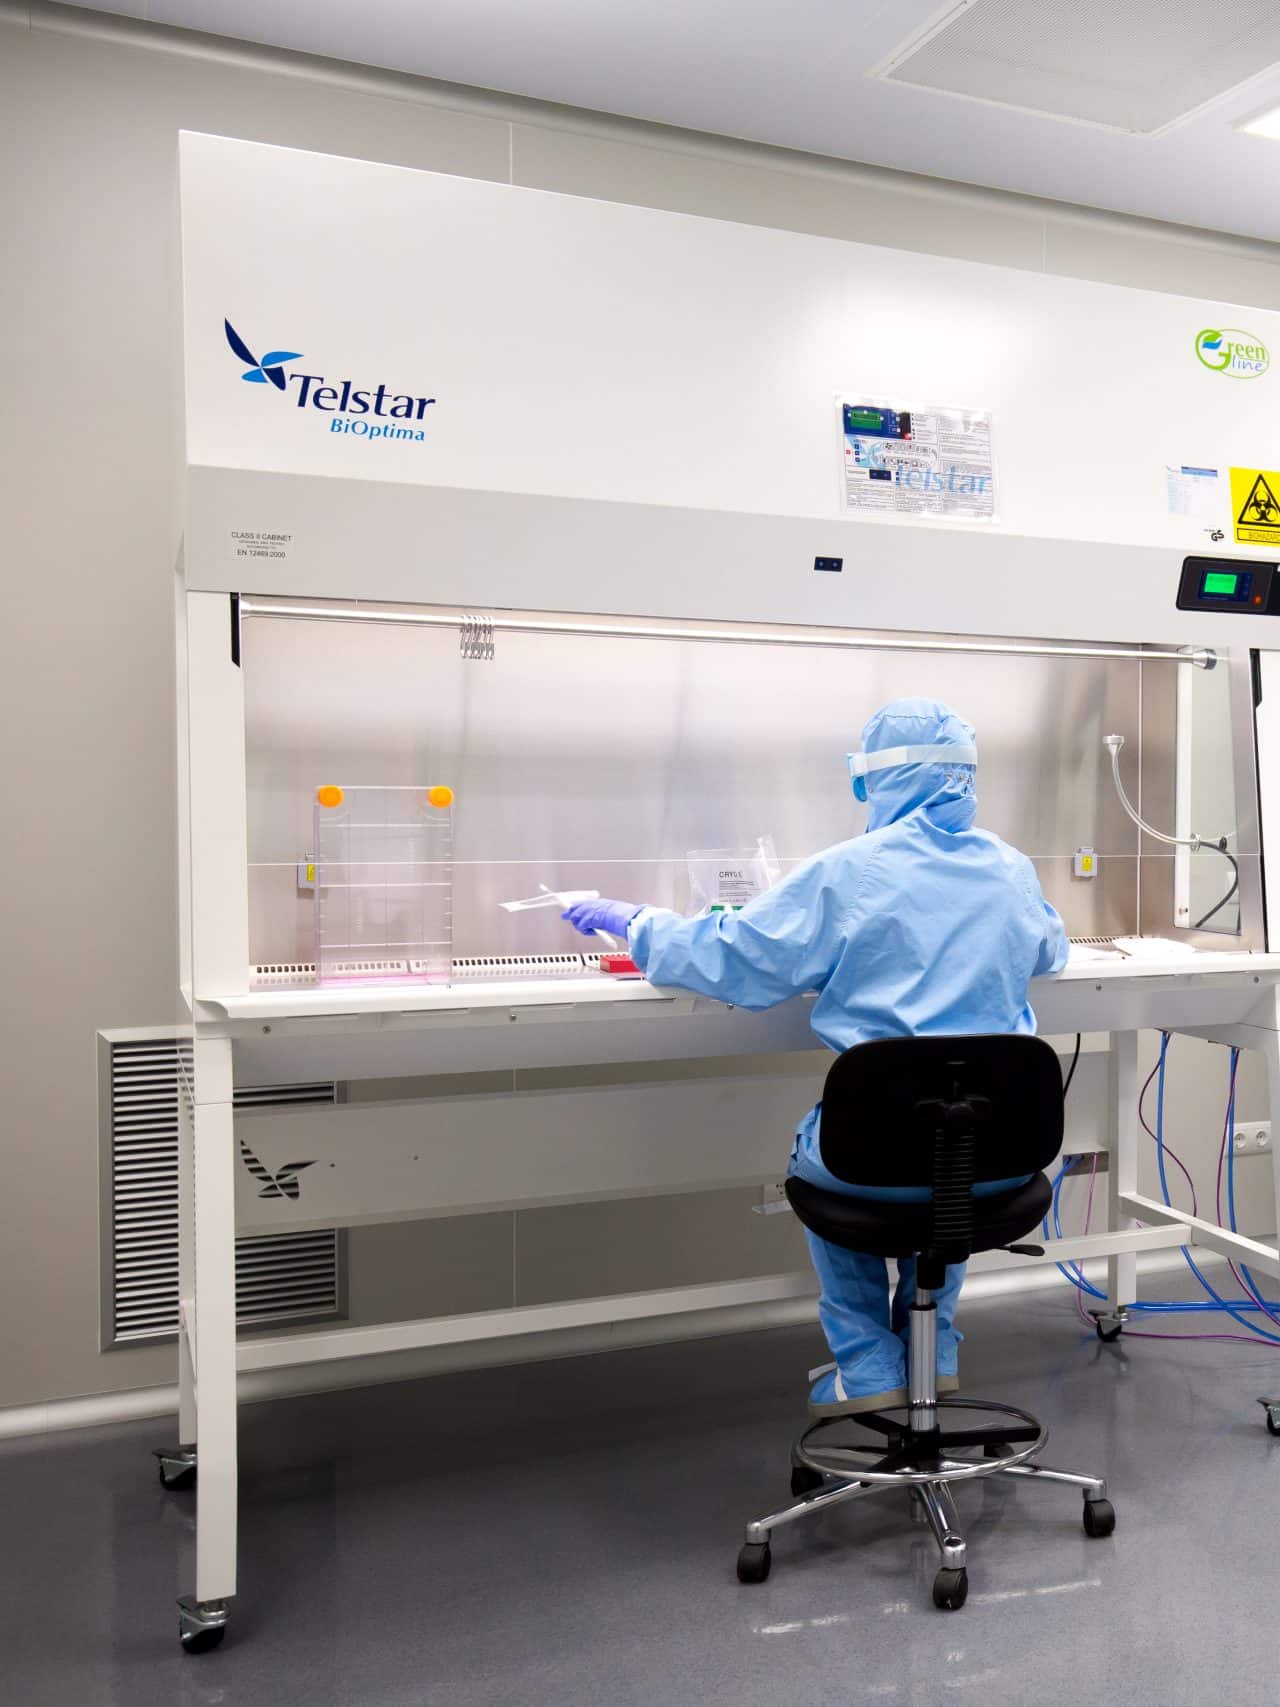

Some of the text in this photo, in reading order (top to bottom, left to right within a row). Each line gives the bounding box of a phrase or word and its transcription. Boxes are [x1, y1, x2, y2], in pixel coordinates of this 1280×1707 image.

[1195, 329, 1266, 370] Green
[1232, 355, 1263, 372] line
[289, 373, 436, 419] Telstar
[330, 418, 425, 441] BiOptima
[231, 531, 254, 540] CLASS
[262, 533, 291, 541] CABINET
